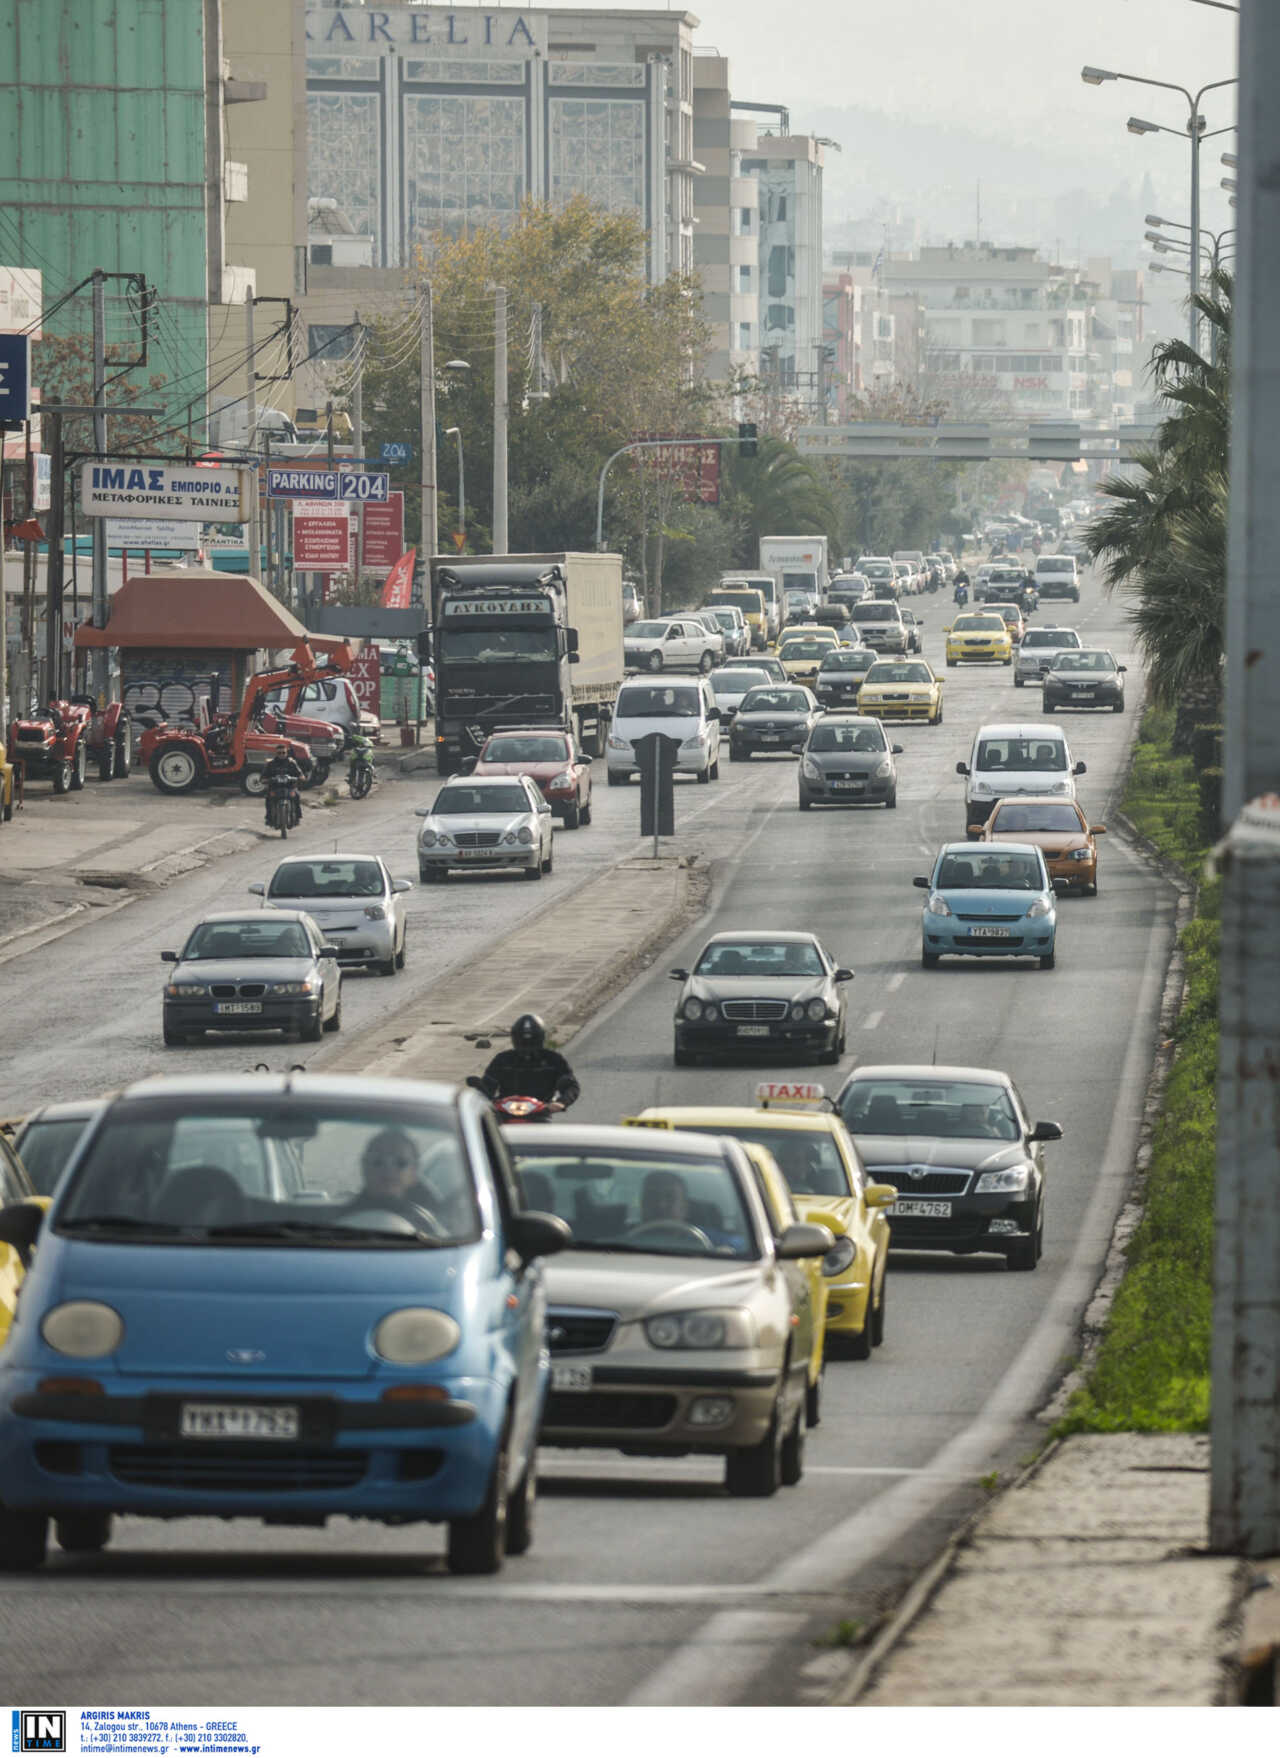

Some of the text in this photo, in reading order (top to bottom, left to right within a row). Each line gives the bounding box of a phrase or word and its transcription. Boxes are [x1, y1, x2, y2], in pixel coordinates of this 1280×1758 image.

[305, 11, 535, 45] ARELIA
[383, 443, 407, 457] 204
[92, 468, 165, 491] ΙΜΑΣ
[171, 481, 222, 494] ΕΜΠΟΡΙΟ
[272, 473, 384, 499] PARKING 204
[92, 493, 241, 508] ΜΕΤΑΦΟΡΙΚΕΣ ΤΑΙΝΙΕΣ
[453, 601, 544, 614] ΛΥΚΟΥΔΗΣ
[767, 1084, 812, 1098] TAXI
